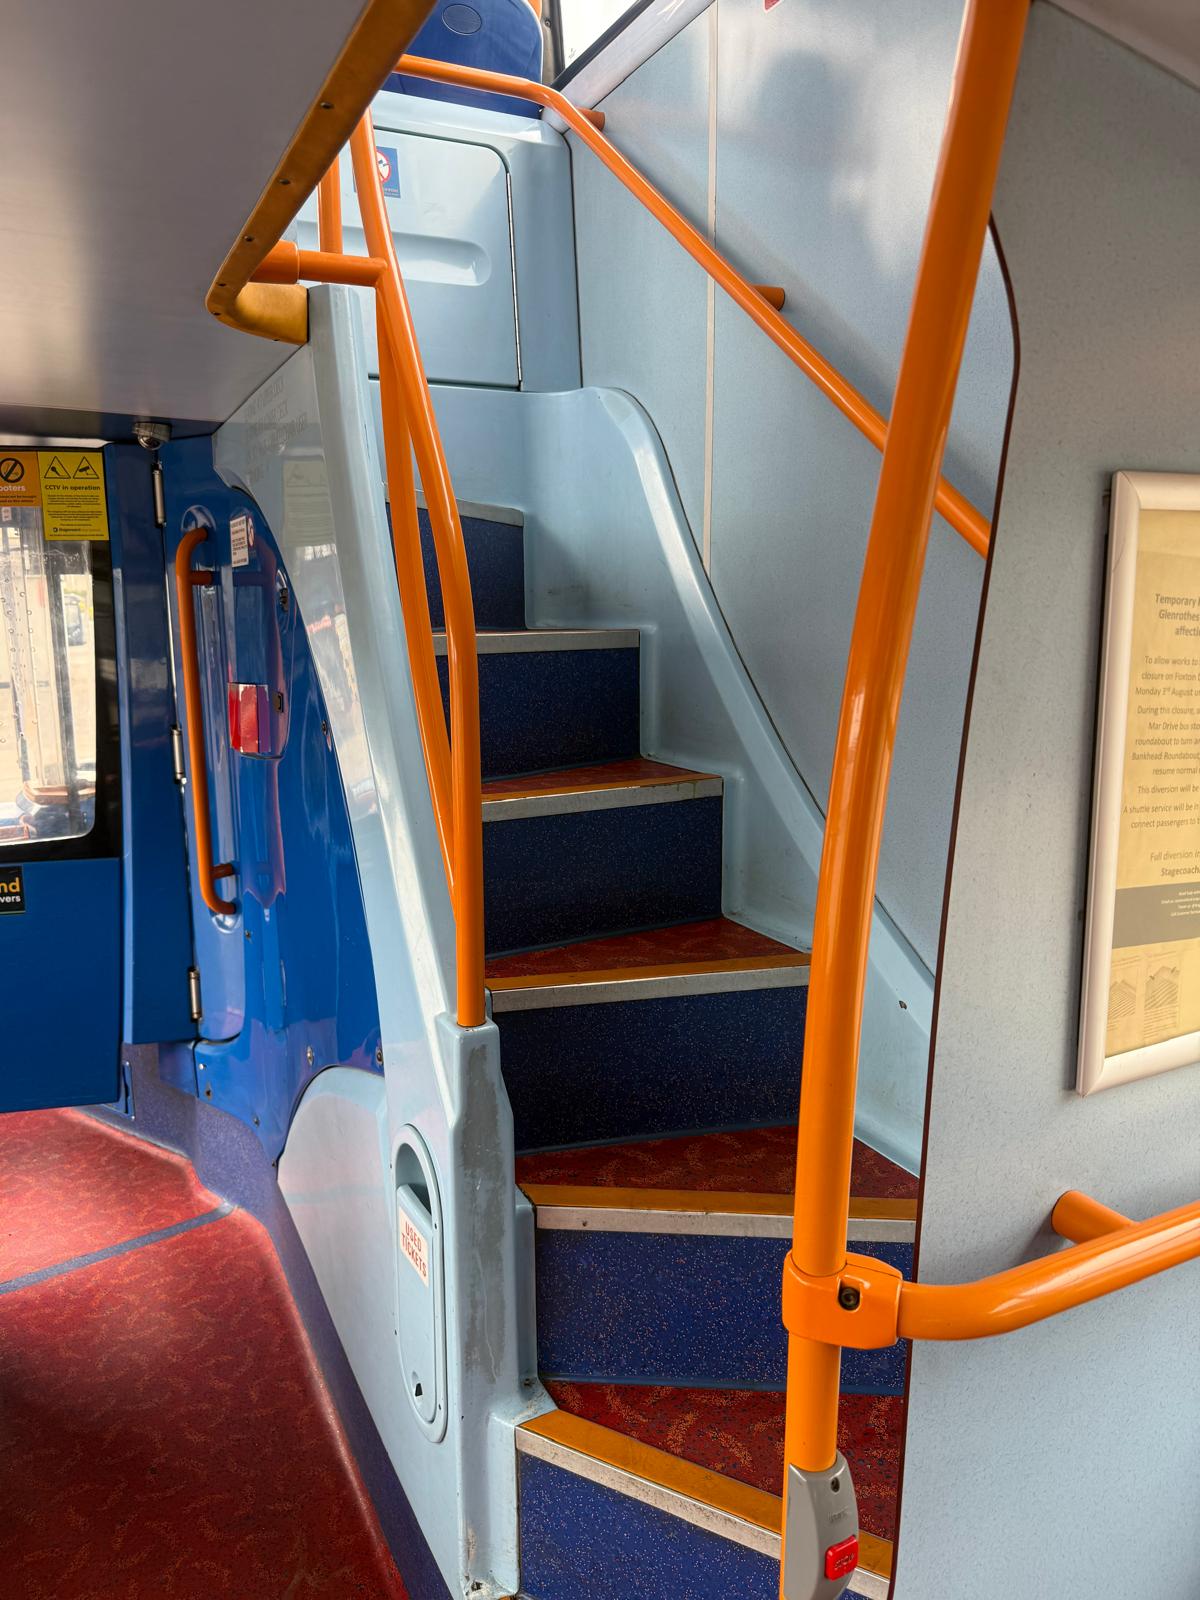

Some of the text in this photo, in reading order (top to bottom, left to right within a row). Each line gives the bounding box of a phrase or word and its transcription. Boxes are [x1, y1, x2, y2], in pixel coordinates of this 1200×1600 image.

[1155, 593, 1197, 608] Temporary
[1158, 609, 1200, 622] Glenrothes
[1145, 655, 1153, 665] To
[1154, 656, 1170, 665] allow
[1171, 656, 1191, 666] works
[1141, 671, 1164, 680] closure
[1174, 672, 1197, 681] Foxton
[1135, 687, 1162, 697] Monday
[1171, 687, 1193, 698] August
[1137, 705, 1159, 716] During
[1160, 706, 1170, 714] this
[1148, 722, 1162, 730] Mar
[1162, 721, 1179, 731] Drive
[1179, 722, 1189, 730] bus
[1135, 738, 1172, 746] roundabout
[1173, 738, 1180, 746] to
[1131, 751, 1163, 761] Bankhead
[1152, 768, 1175, 776] resume
[1176, 766, 1198, 775] normal
[1138, 784, 1199, 794] This diversion will be
[1129, 805, 1150, 814] shuttle
[1173, 804, 1185, 812] will
[1185, 803, 1193, 811] be
[1131, 820, 1155, 829] connect
[1156, 818, 1188, 829] passengers
[1189, 817, 1196, 826] to
[1150, 852, 1162, 862] Full
[1163, 850, 1193, 861] diversion
[1161, 866, 1200, 878] Stagecoach
[405, 1221, 422, 1252] USED
[401, 1232, 427, 1277] TICKETS
